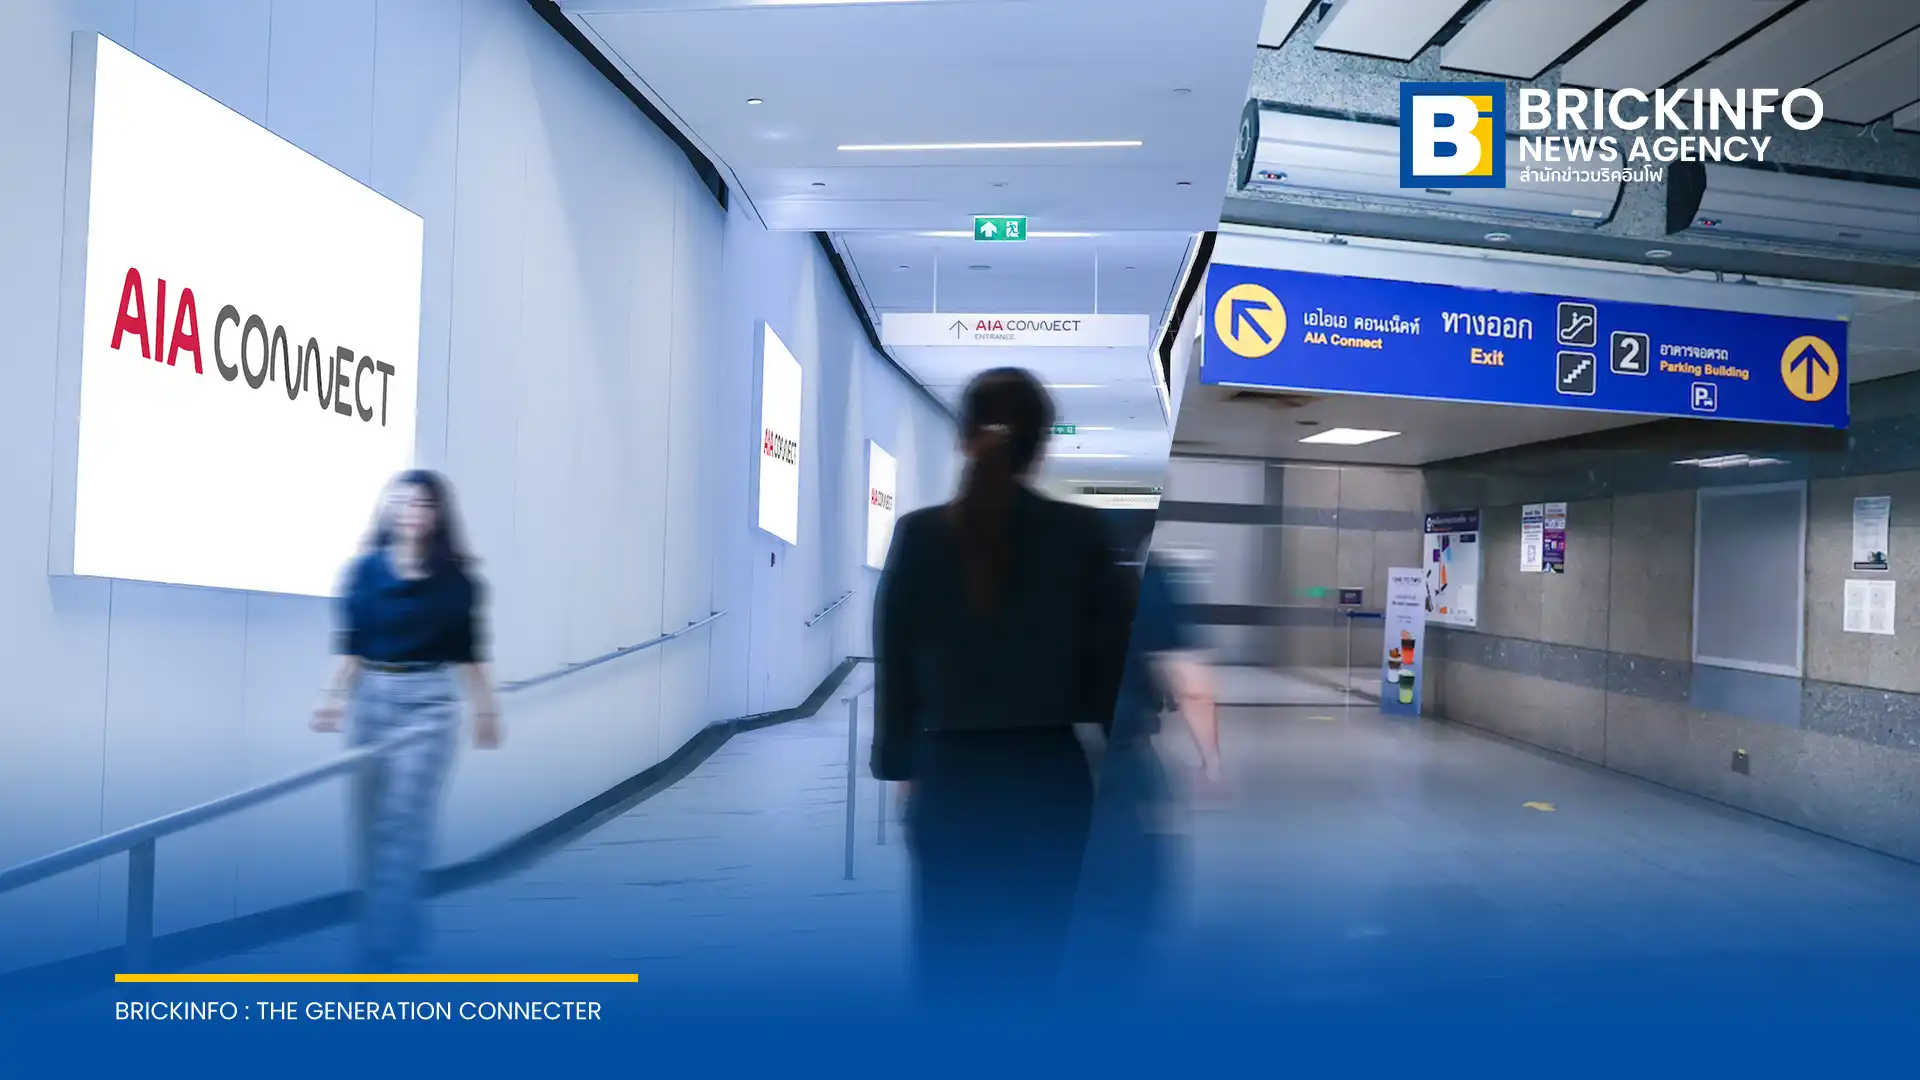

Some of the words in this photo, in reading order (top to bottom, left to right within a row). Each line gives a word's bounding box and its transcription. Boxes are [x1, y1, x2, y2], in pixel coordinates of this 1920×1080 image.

[975, 320, 1003, 331] AIA
[1006, 320, 1081, 331] CONNECT
[1303, 307, 1348, 328] เอไอเอ
[1441, 310, 1533, 340] ทางออก
[110, 267, 203, 375] AIA
[213, 304, 395, 427] CONNECT
[1304, 331, 1328, 345] AIA
[1330, 333, 1383, 350] Connect
[1470, 347, 1504, 366] Exit
[1619, 336, 1640, 370] 2
[1659, 343, 1729, 361] อาคารจอดรถ
[1659, 359, 1702, 376] Parking
[1704, 363, 1749, 380] Building
[763, 428, 774, 458] AIA
